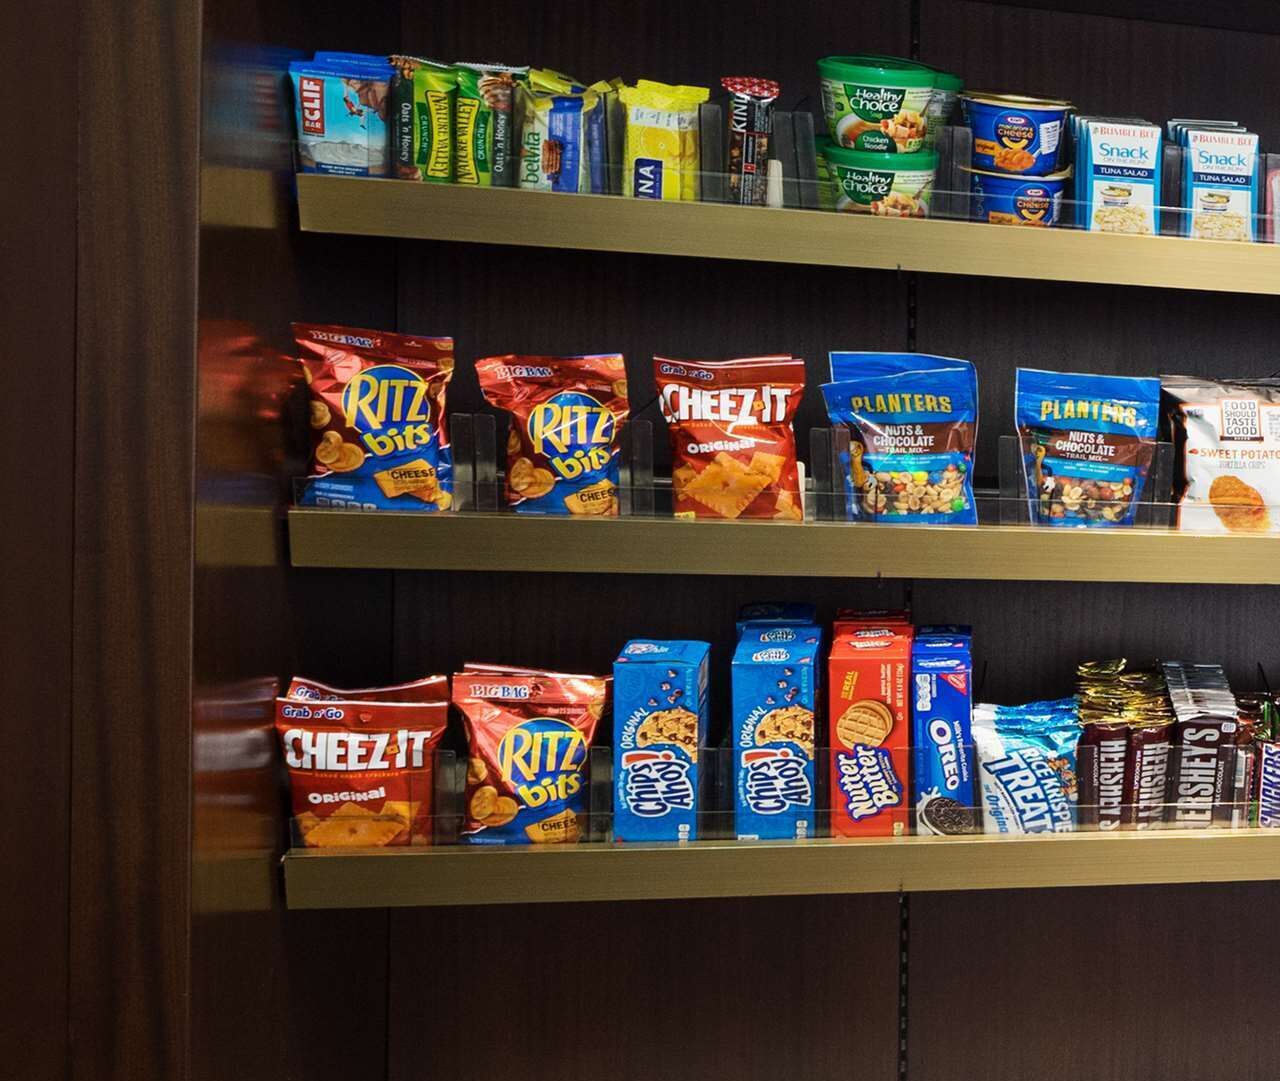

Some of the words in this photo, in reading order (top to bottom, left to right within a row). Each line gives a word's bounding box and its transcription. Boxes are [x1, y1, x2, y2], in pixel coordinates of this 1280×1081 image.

[303, 79, 321, 121] CLIF
[850, 98, 899, 113] Choice
[856, 88, 902, 105] Healthy
[401, 103, 412, 122] Oats
[431, 94, 448, 136] NATURE
[458, 100, 476, 138] VALLEY
[496, 113, 506, 140] Honey
[400, 135, 412, 162] Honey
[863, 135, 889, 143] Chicken
[431, 137, 448, 175] VALLEY
[458, 139, 475, 180] NATURE
[521, 131, 540, 184] belvita
[1100, 142, 1149, 159] Snack
[1199, 150, 1247, 166] Snack
[495, 152, 505, 172] Oats
[1100, 166, 1122, 175] TUNA
[1123, 168, 1148, 177] SALAD
[842, 180, 888, 194] Choice
[846, 171, 891, 186] Healthy
[1200, 174, 1221, 182] TUNA
[1222, 176, 1246, 184] SALAD
[495, 366, 524, 379] BIG
[526, 367, 552, 377] BAG
[660, 363, 686, 377] Grab
[697, 370, 714, 381] Go
[345, 374, 429, 430] RITZ
[852, 393, 952, 413] PLANTERS
[1224, 400, 1256, 410] FOOD
[1040, 400, 1136, 426] PLANTERS
[1226, 417, 1256, 426] TASTE
[534, 402, 612, 454] RITZ
[884, 424, 913, 436] NUTS
[914, 425, 924, 436] &
[1069, 431, 1096, 443] NUTS
[1096, 433, 1105, 444] &
[1226, 426, 1257, 436] GOOD
[362, 423, 433, 456] bits
[873, 435, 934, 447] CHOCOLATE
[1055, 440, 1116, 456] CHOCOLATE
[1201, 447, 1238, 458] SWEET
[391, 467, 435, 480] CHEESE
[552, 450, 611, 481] bits
[470, 684, 499, 697] BIG
[501, 686, 529, 698] BAG
[282, 705, 310, 718] Grab
[324, 709, 343, 720] Go
[621, 707, 650, 749] ORIGINAL
[740, 705, 768, 748] ORIGINAL
[501, 728, 587, 784] RITZ
[930, 719, 960, 790] OREO
[838, 753, 875, 819] Nutter
[857, 745, 899, 807] Butter
[518, 772, 582, 808] bits
[628, 763, 668, 816] Chips
[747, 761, 787, 814] Chips
[983, 751, 1053, 832] TREAT
[1021, 747, 1056, 777] RICE
[1041, 777, 1073, 832] KRISPIE
